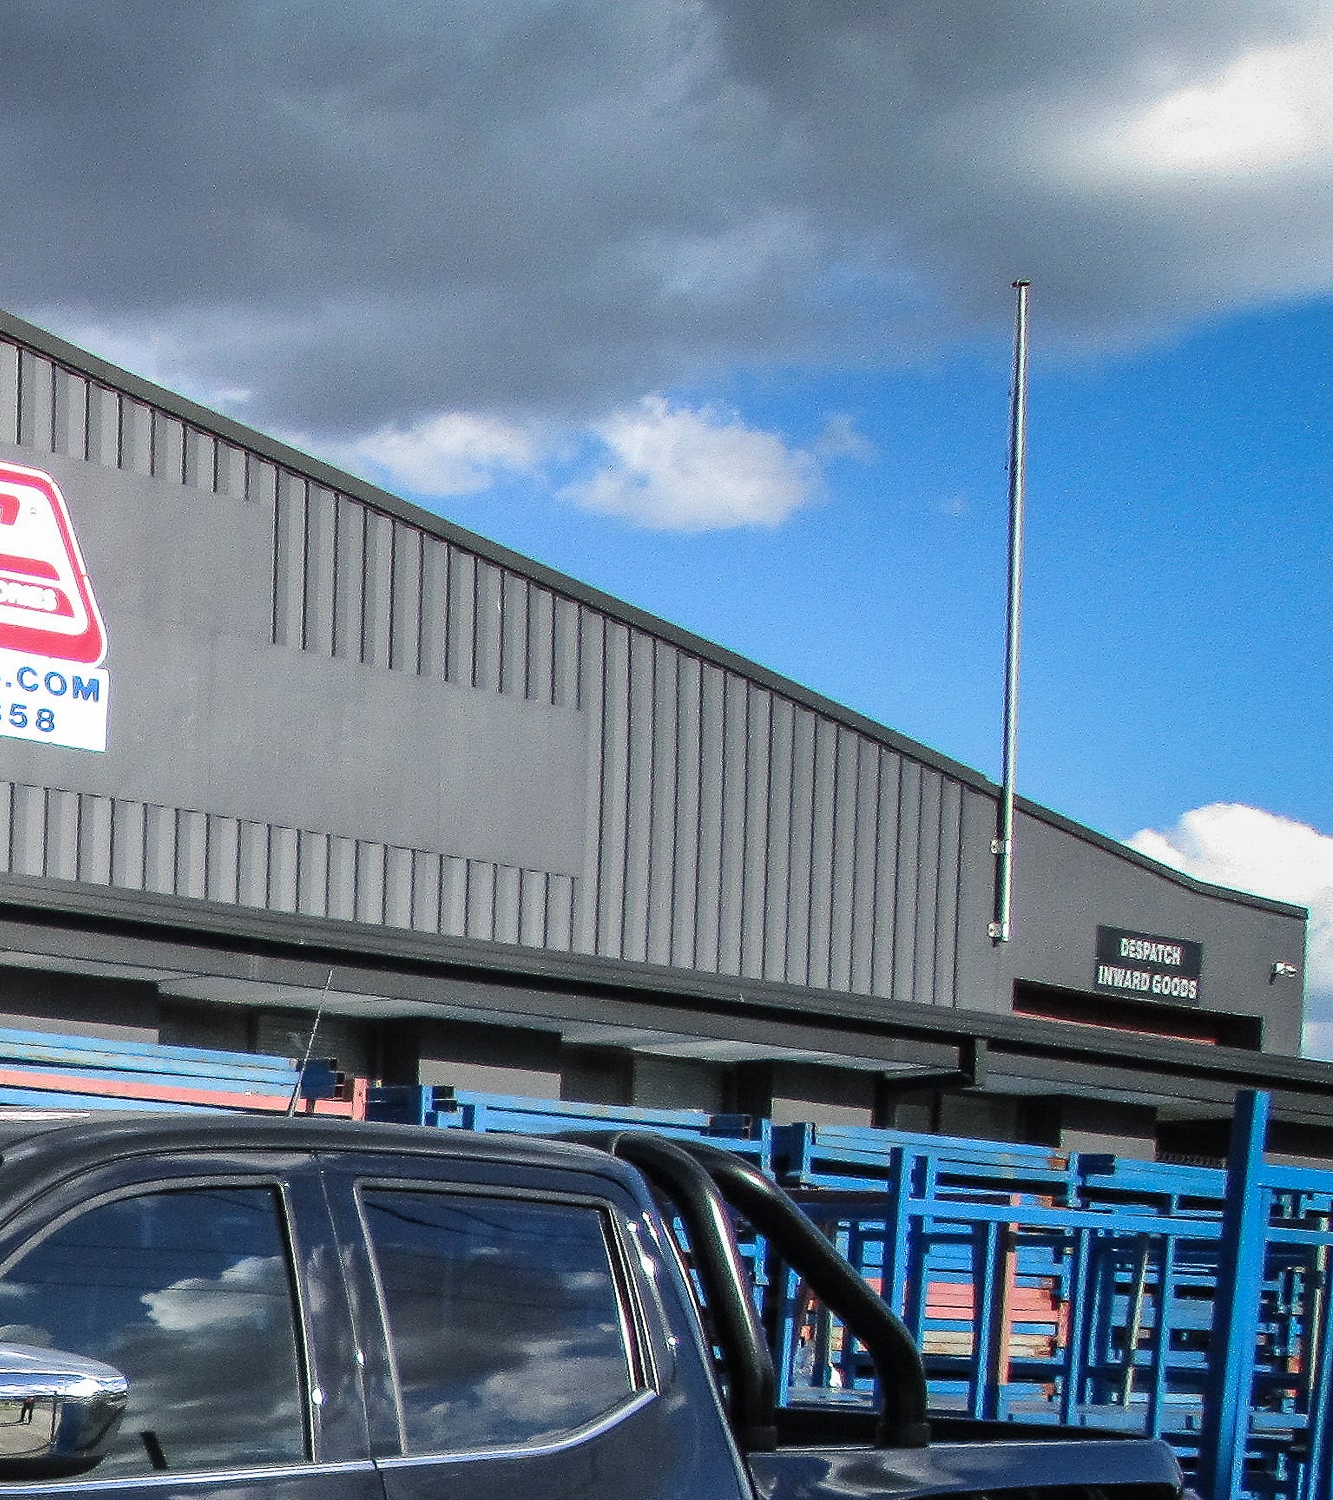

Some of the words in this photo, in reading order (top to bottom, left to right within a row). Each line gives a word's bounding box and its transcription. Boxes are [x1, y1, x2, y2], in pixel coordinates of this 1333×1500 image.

[1119, 938, 1182, 966] DESPATCH
[1097, 965, 1150, 991] INWARD
[1152, 976, 1198, 1000] GOODS
